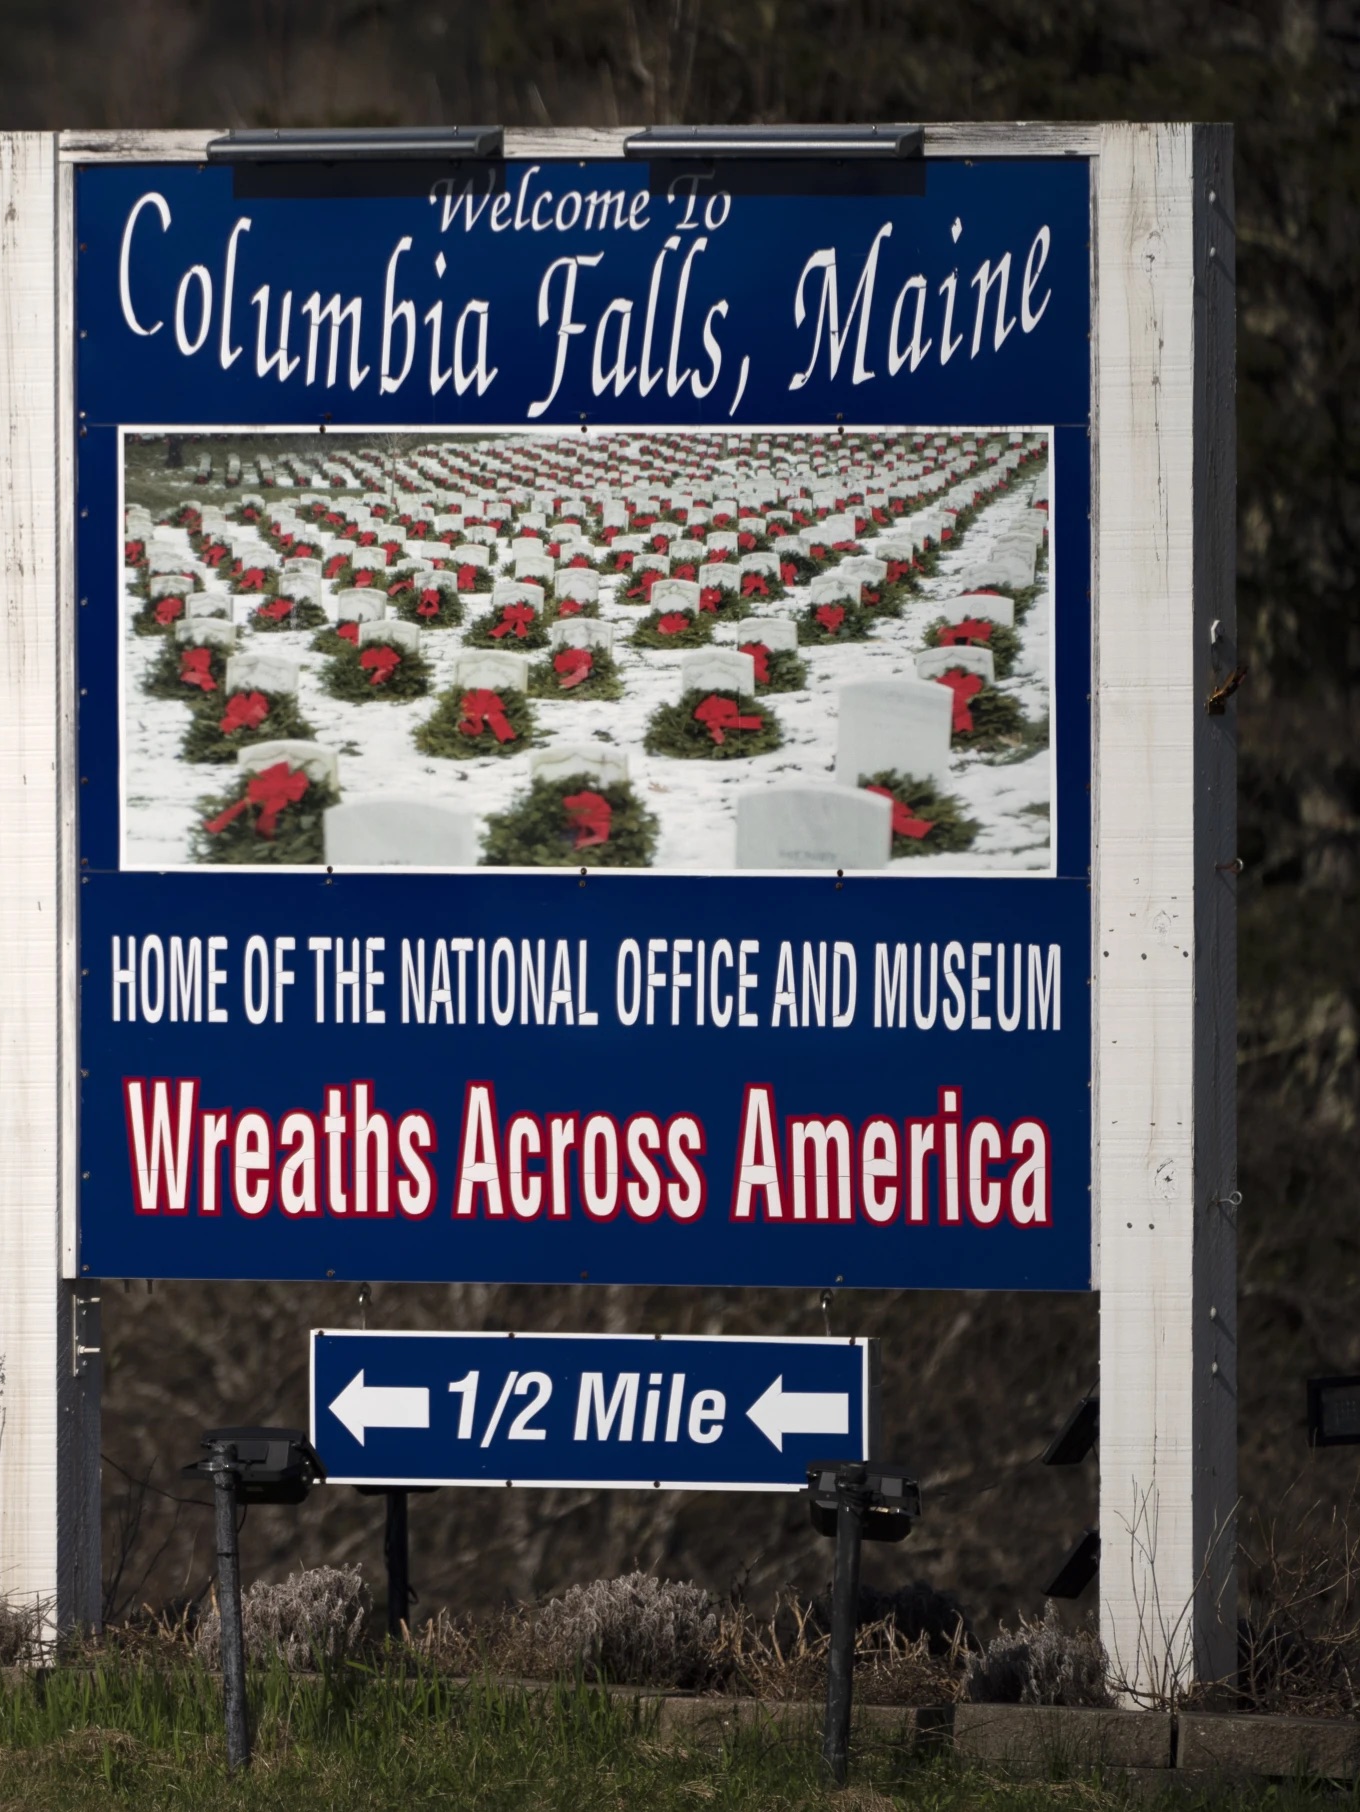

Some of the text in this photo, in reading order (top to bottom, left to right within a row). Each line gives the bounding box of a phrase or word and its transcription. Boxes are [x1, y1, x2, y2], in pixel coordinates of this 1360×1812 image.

[429, 165, 733, 233] Welcome To
[119, 191, 1053, 418] Columbia Falls, Maine
[111, 933, 1062, 1032] HOME OF THE NATIONAL OFFICE AND MUSEUM
[124, 1077, 1051, 1228] Wreaths Across America
[448, 1370, 727, 1449] 1/2 Mile
